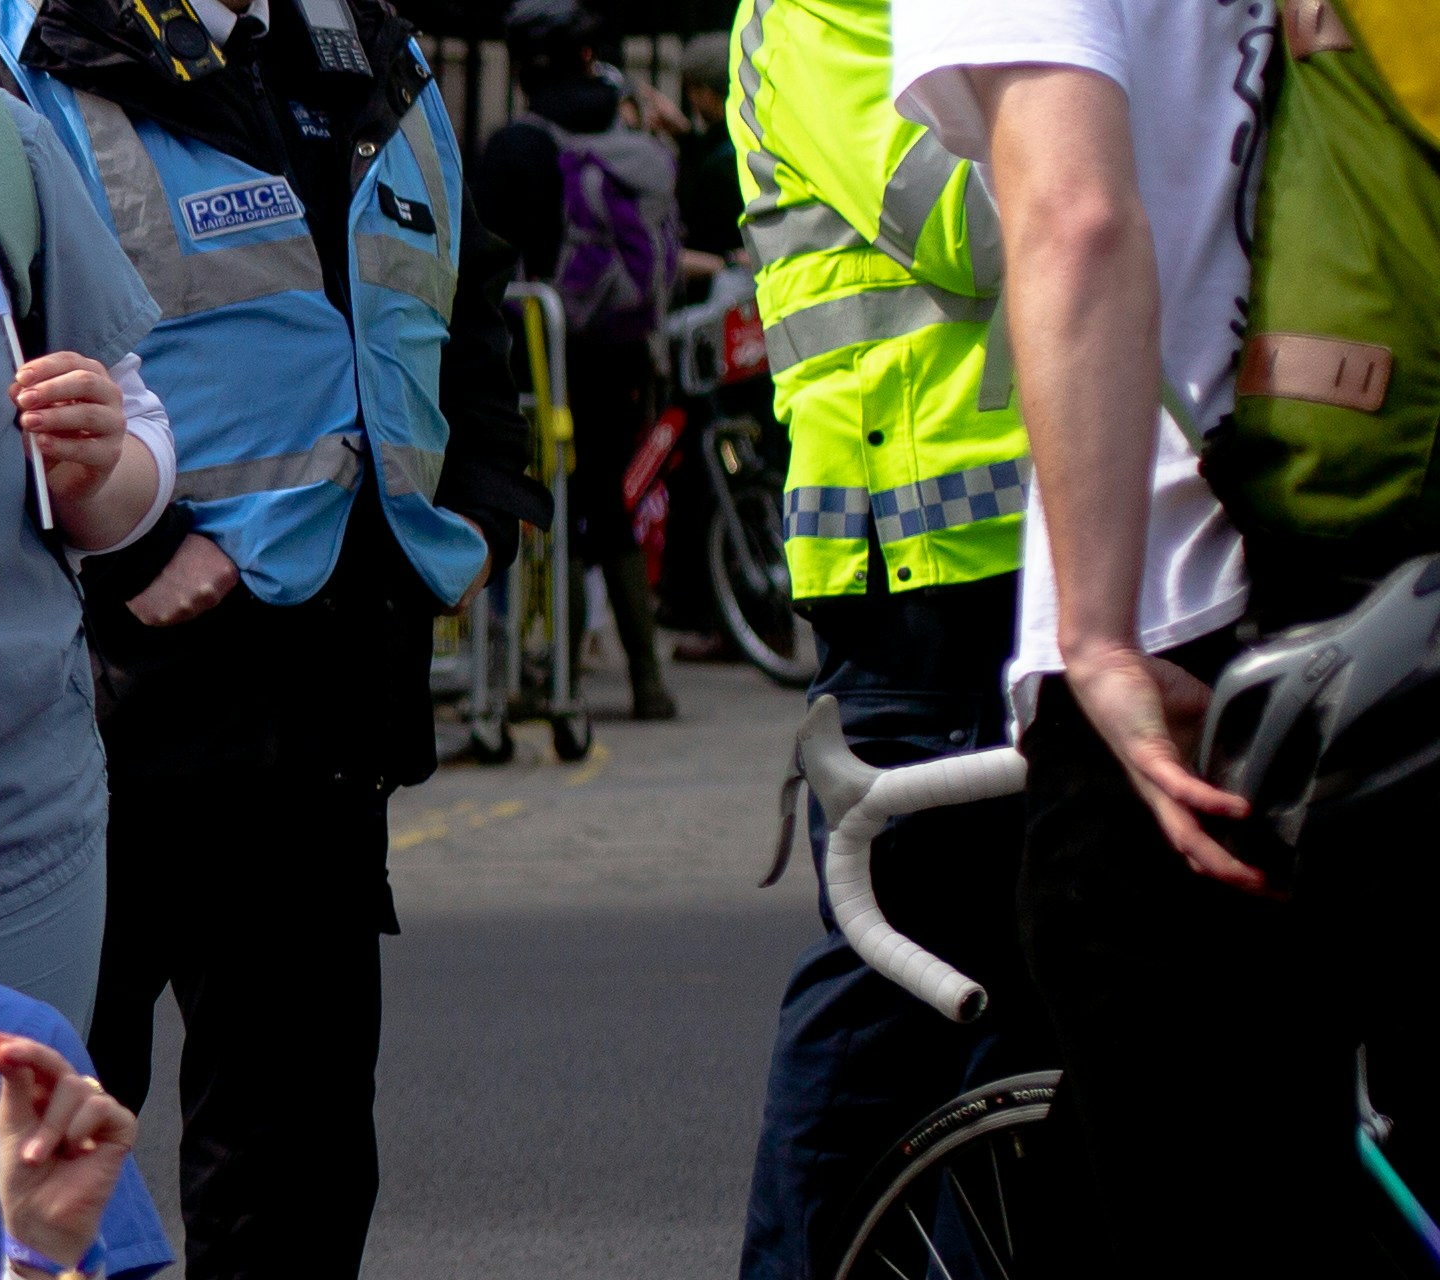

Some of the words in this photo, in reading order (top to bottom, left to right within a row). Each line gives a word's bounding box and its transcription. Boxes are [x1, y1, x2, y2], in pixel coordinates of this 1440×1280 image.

[190, 184, 291, 221] POLICE
[195, 212, 244, 233] LIAISON
[245, 203, 295, 221] OFFICER
[910, 1098, 988, 1150] HUTCHINSON
